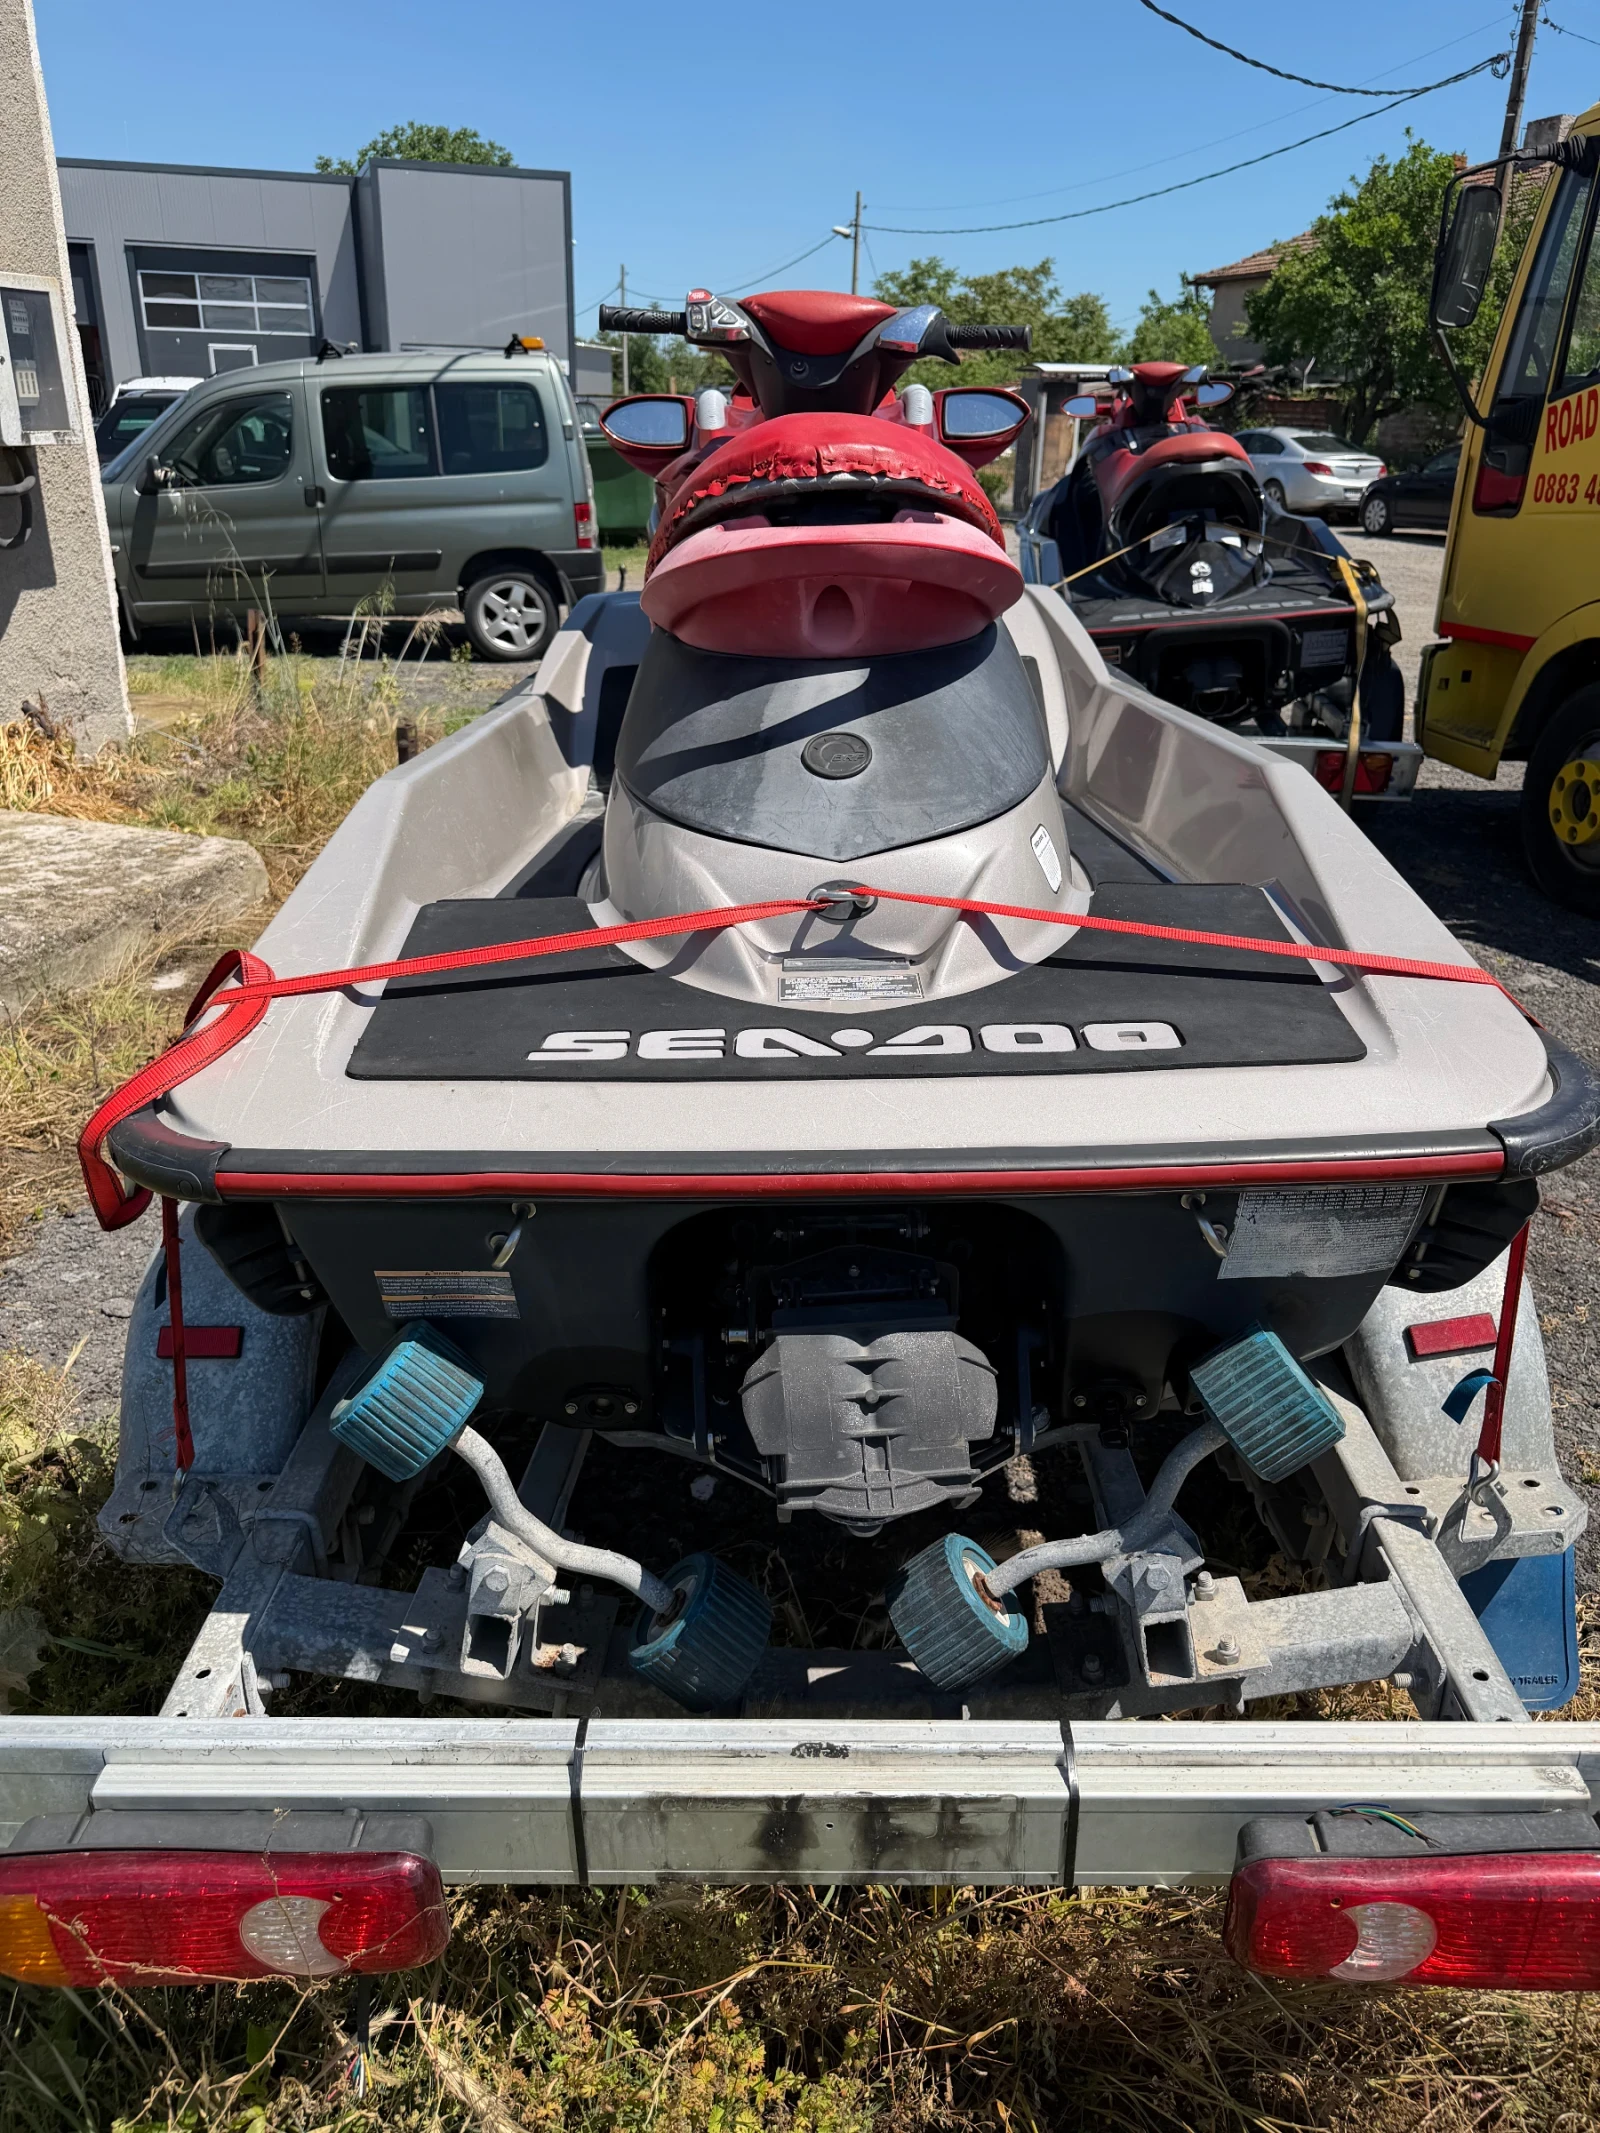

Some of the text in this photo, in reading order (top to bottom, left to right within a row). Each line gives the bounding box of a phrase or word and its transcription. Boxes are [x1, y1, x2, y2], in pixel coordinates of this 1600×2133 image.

[1545, 388, 1599, 454] ROAD
[1533, 473, 1580, 504] 0883
[1518, 1675, 1559, 1686] TRAILER
